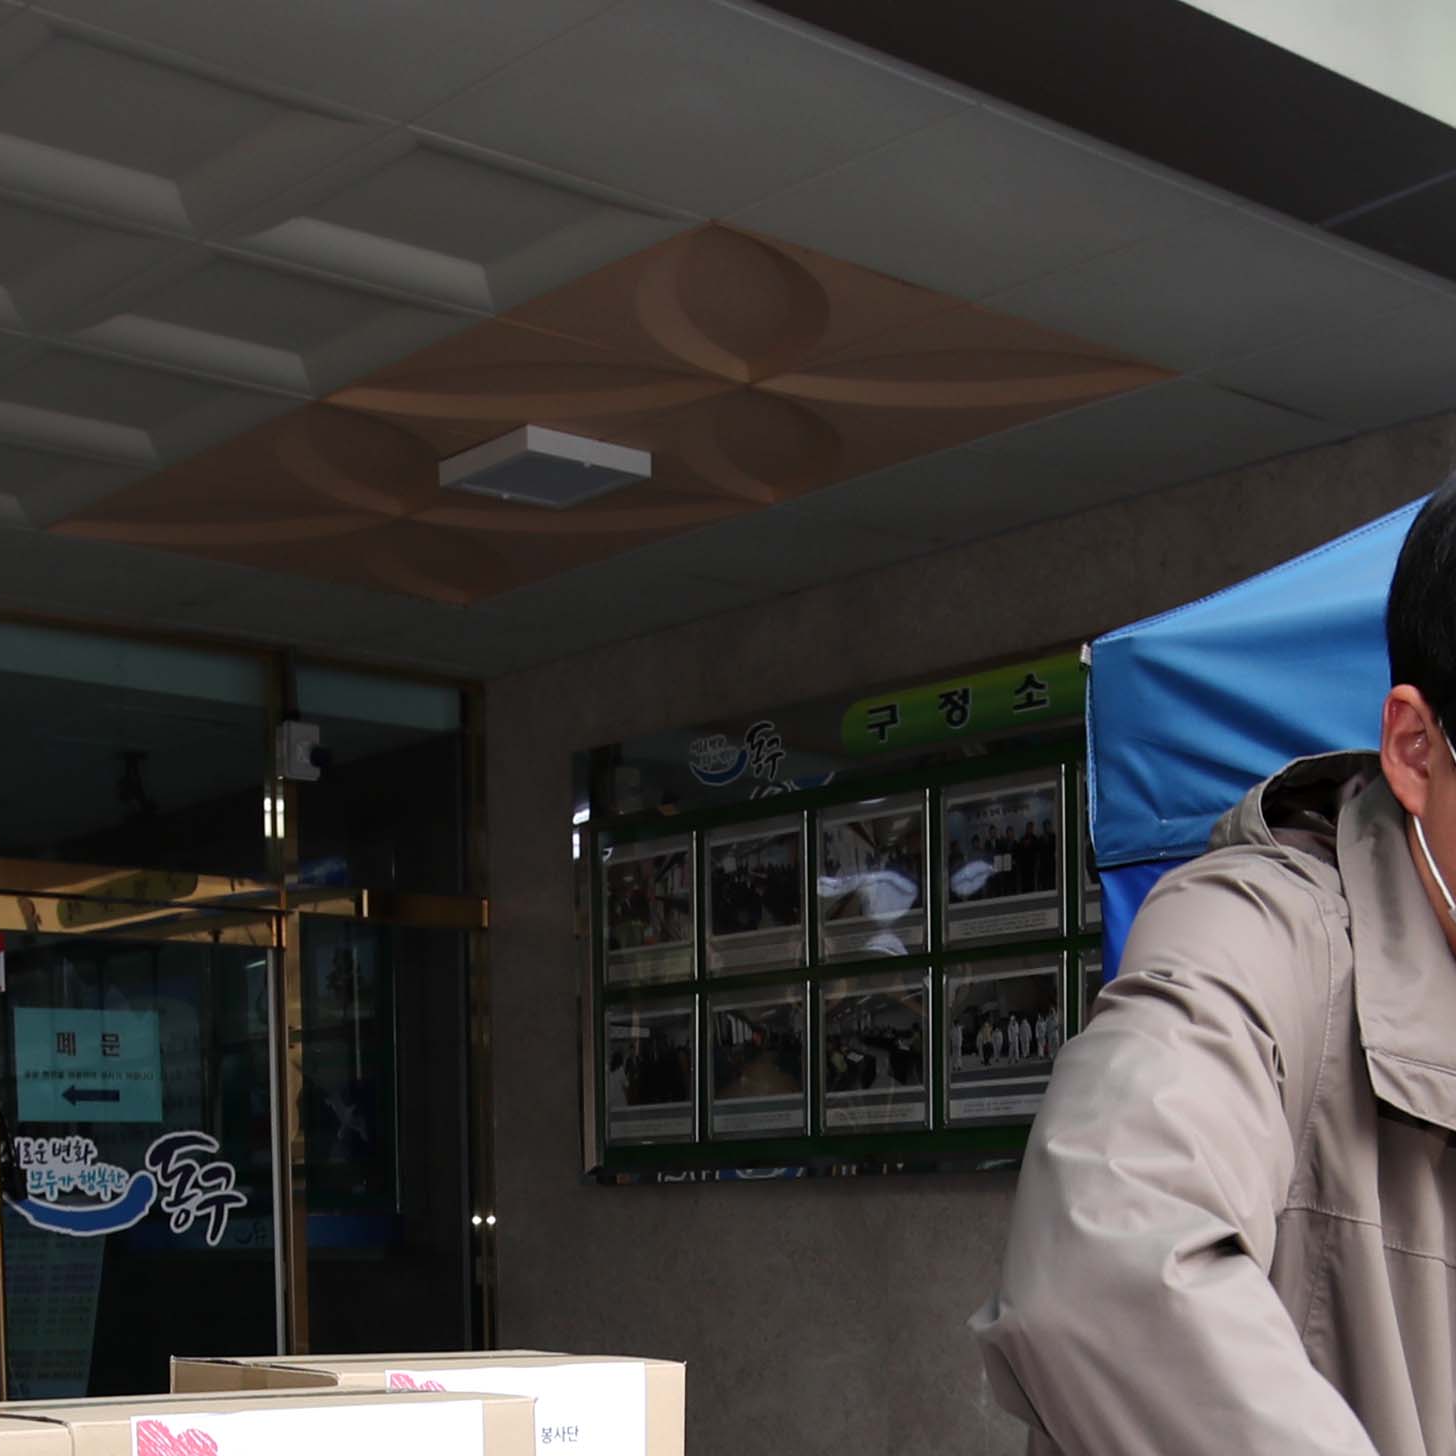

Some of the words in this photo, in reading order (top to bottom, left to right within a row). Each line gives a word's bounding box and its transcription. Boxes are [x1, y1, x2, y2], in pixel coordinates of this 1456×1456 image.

[52, 1139, 94, 1164] 변화
[30, 1170, 74, 1195] 모두가
[79, 1168, 126, 1194] 행복한
[148, 1134, 246, 1244] 동구
[540, 1425, 579, 1445] 봉사단
